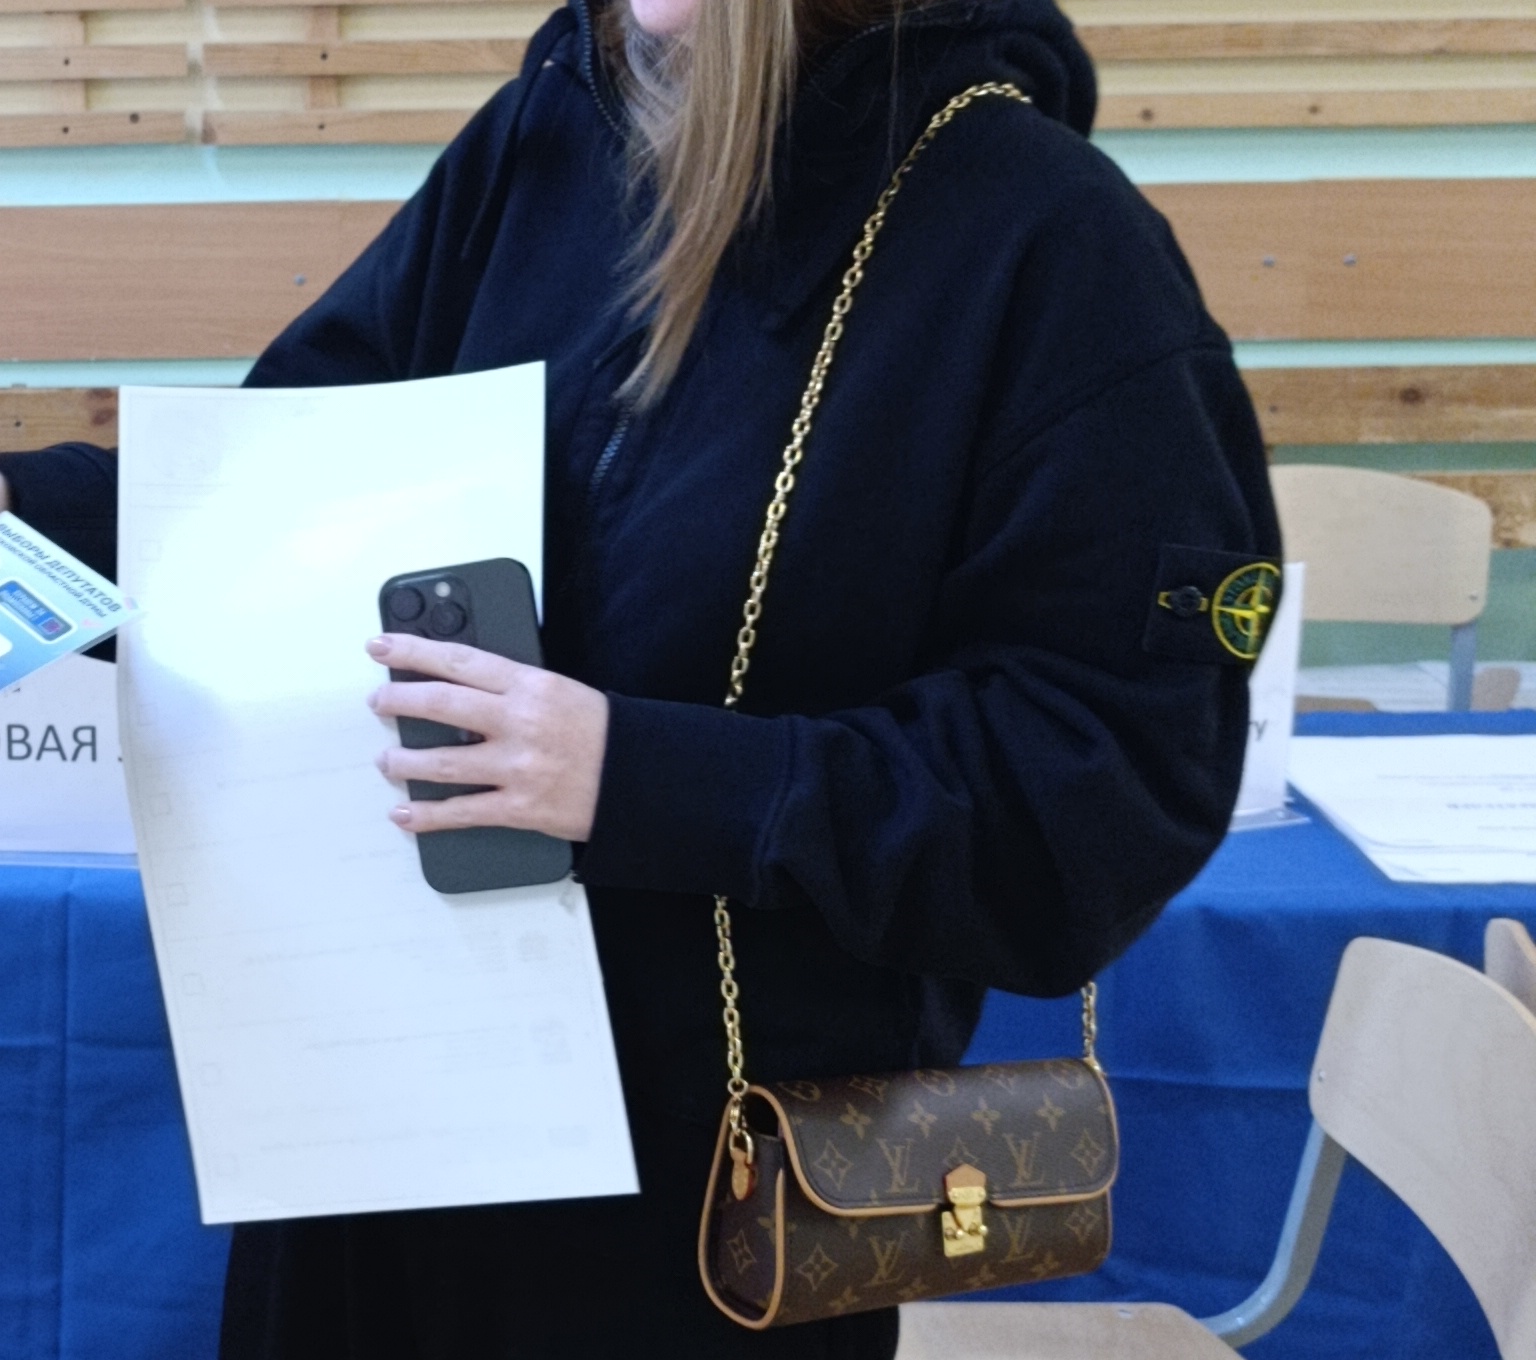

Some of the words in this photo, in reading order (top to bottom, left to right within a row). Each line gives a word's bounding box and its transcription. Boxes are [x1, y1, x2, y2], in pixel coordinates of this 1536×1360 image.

[34, 561, 83, 599] ОБЛАСТНОЙ
[79, 596, 107, 618] ДУМЫ
[46, 560, 122, 612] ДЕПУТАТОВ
